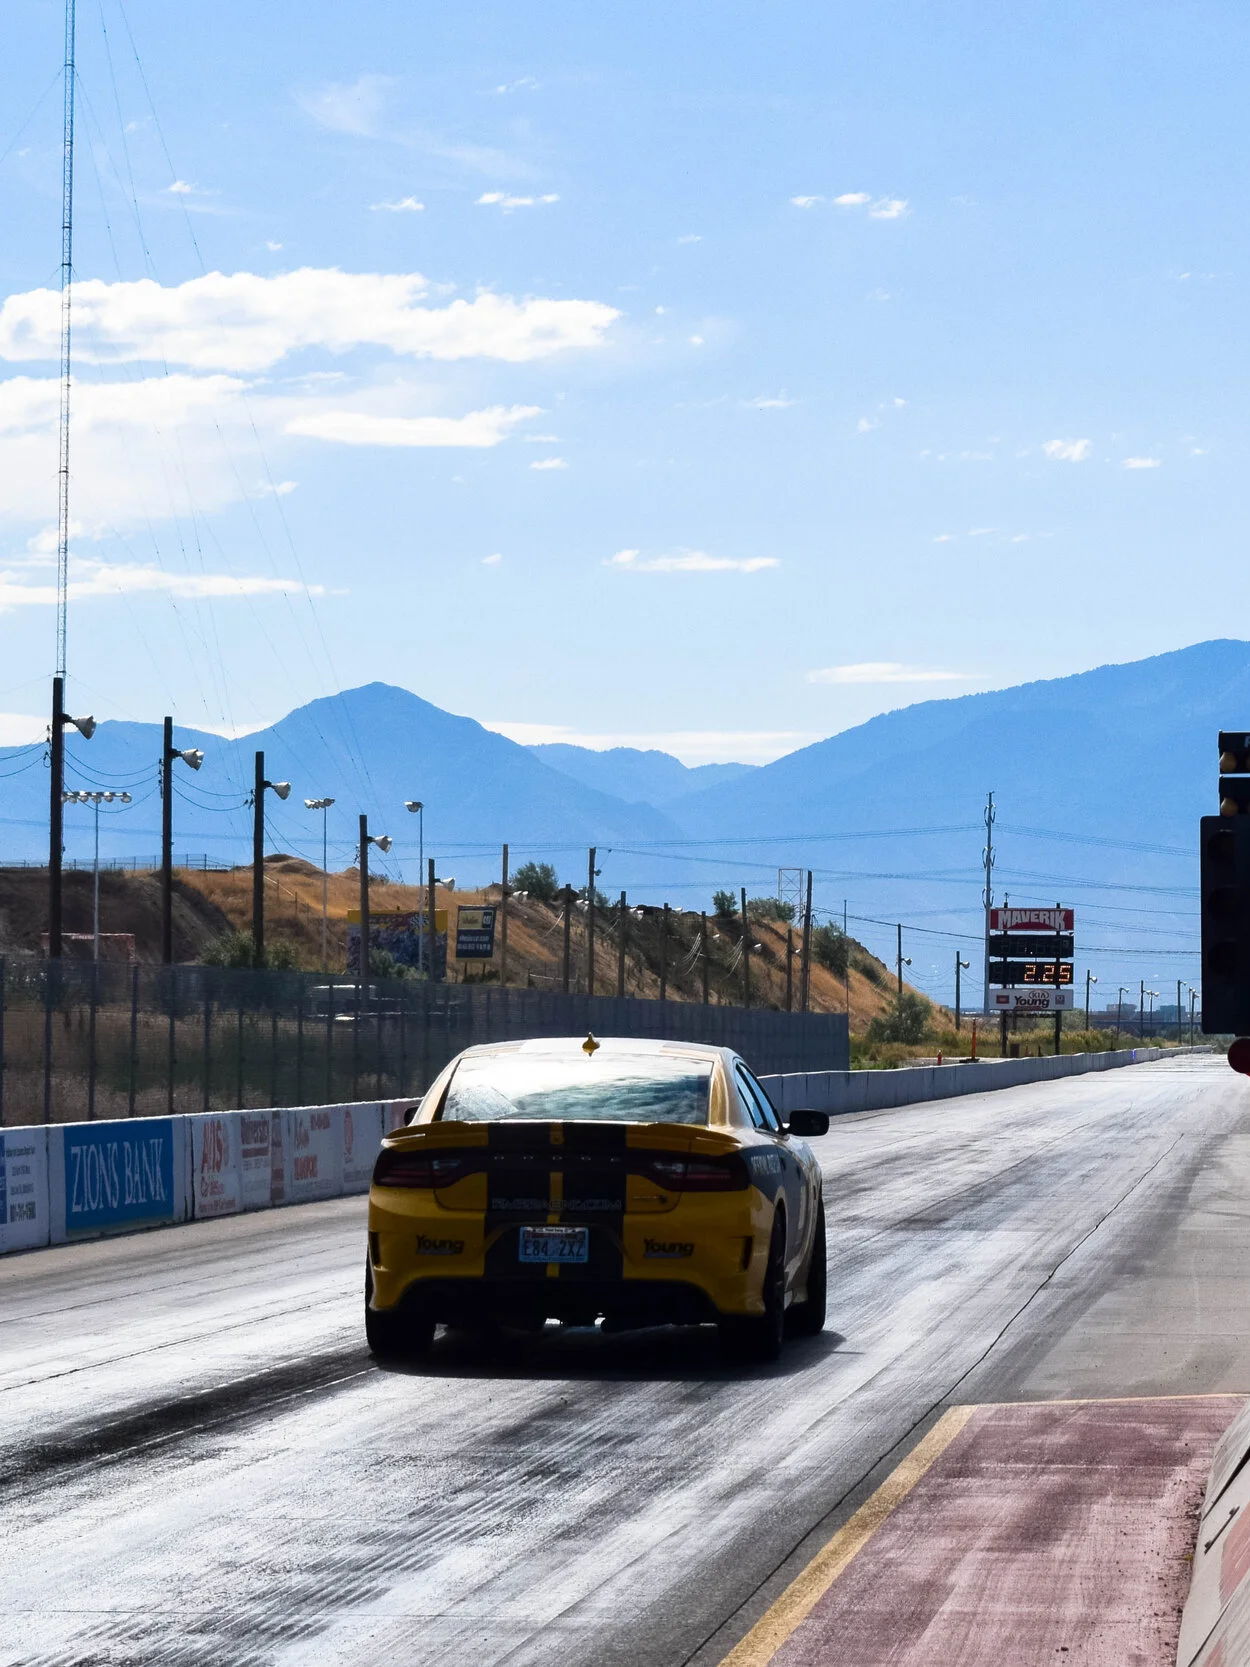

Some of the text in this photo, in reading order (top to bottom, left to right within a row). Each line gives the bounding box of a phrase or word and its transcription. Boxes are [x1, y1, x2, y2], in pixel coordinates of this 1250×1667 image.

[997, 910, 1066, 930] MAVERIK
[1023, 964, 1071, 982] 2.25
[1014, 995, 1050, 1008] Young
[70, 1138, 167, 1212] ZIONS BANK
[415, 1234, 464, 1254] Young
[643, 1238, 695, 1257] Young
